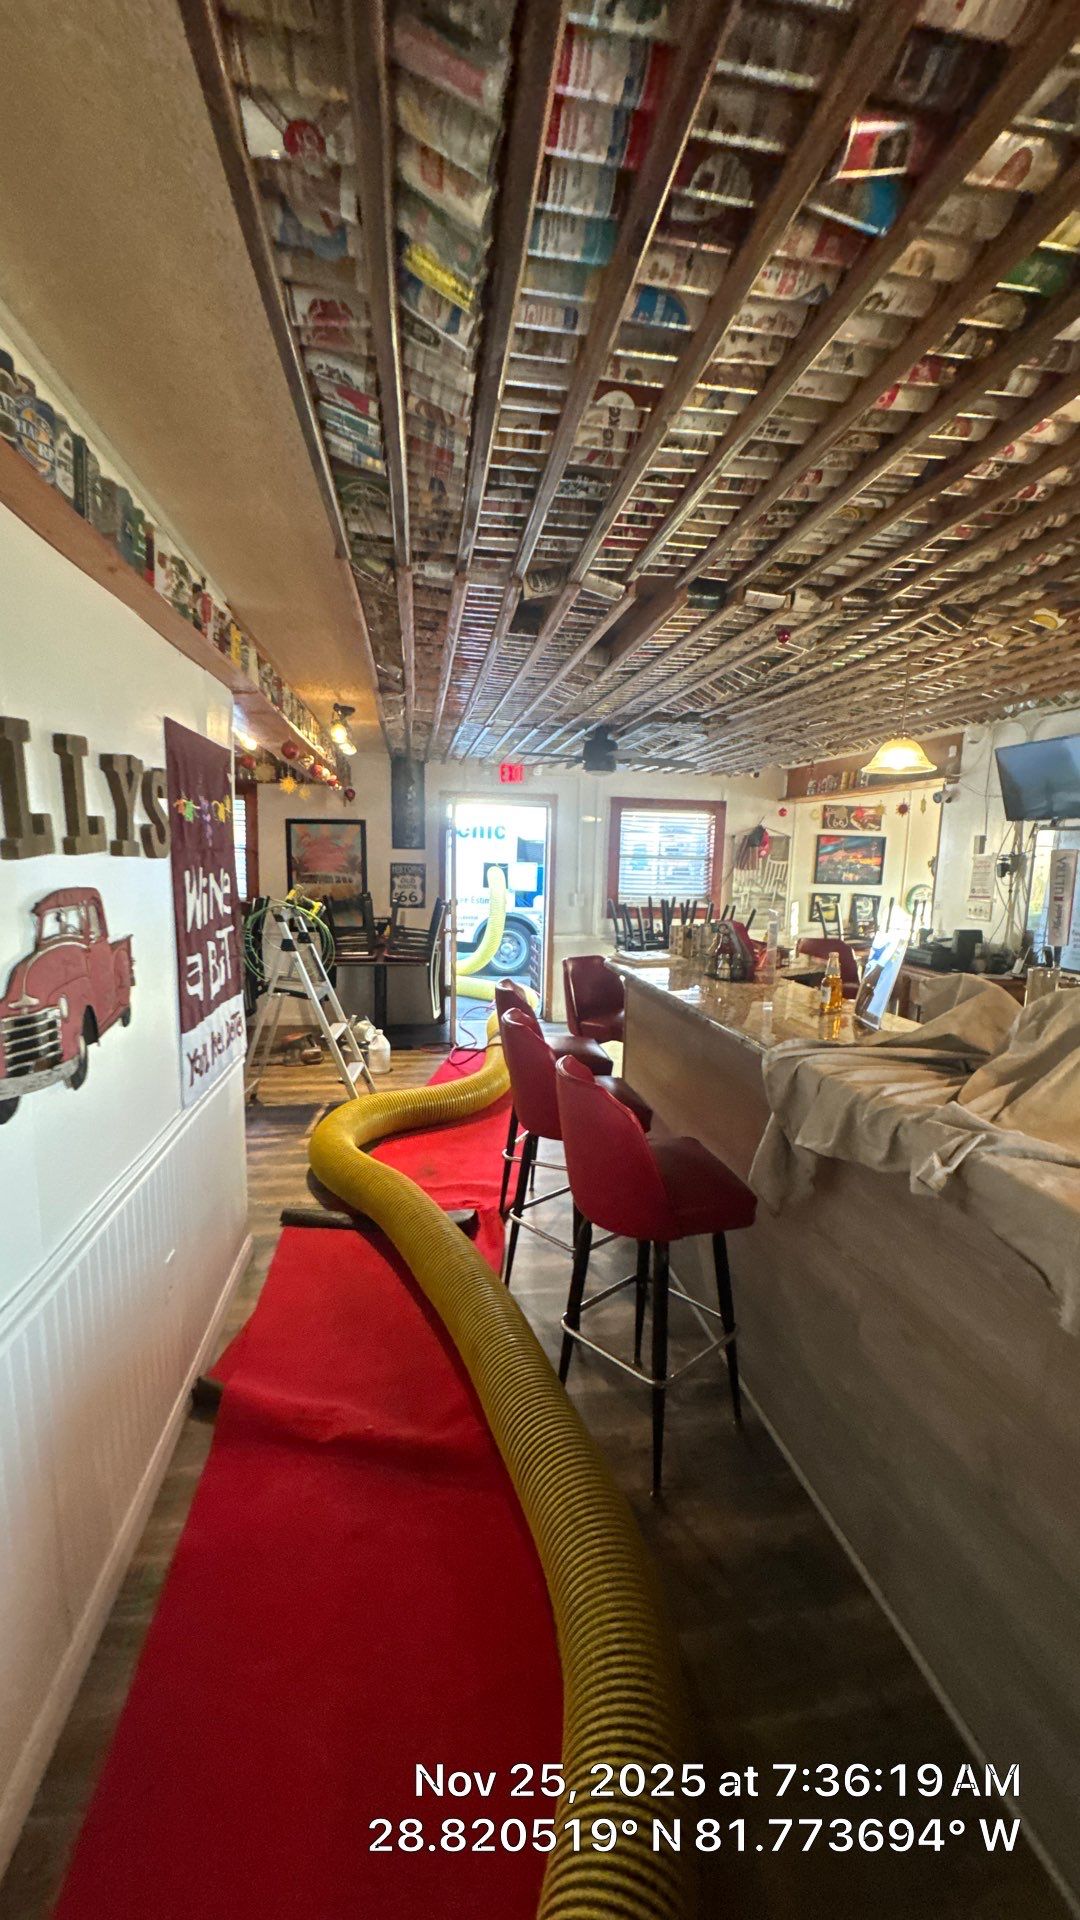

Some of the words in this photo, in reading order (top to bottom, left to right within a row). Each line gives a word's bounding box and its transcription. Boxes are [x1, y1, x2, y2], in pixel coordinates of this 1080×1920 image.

[501, 763, 525, 783] EXIT
[392, 864, 425, 873] HISTORIC
[1054, 857, 1067, 895] ULTRA
[399, 891, 418, 903] 66
